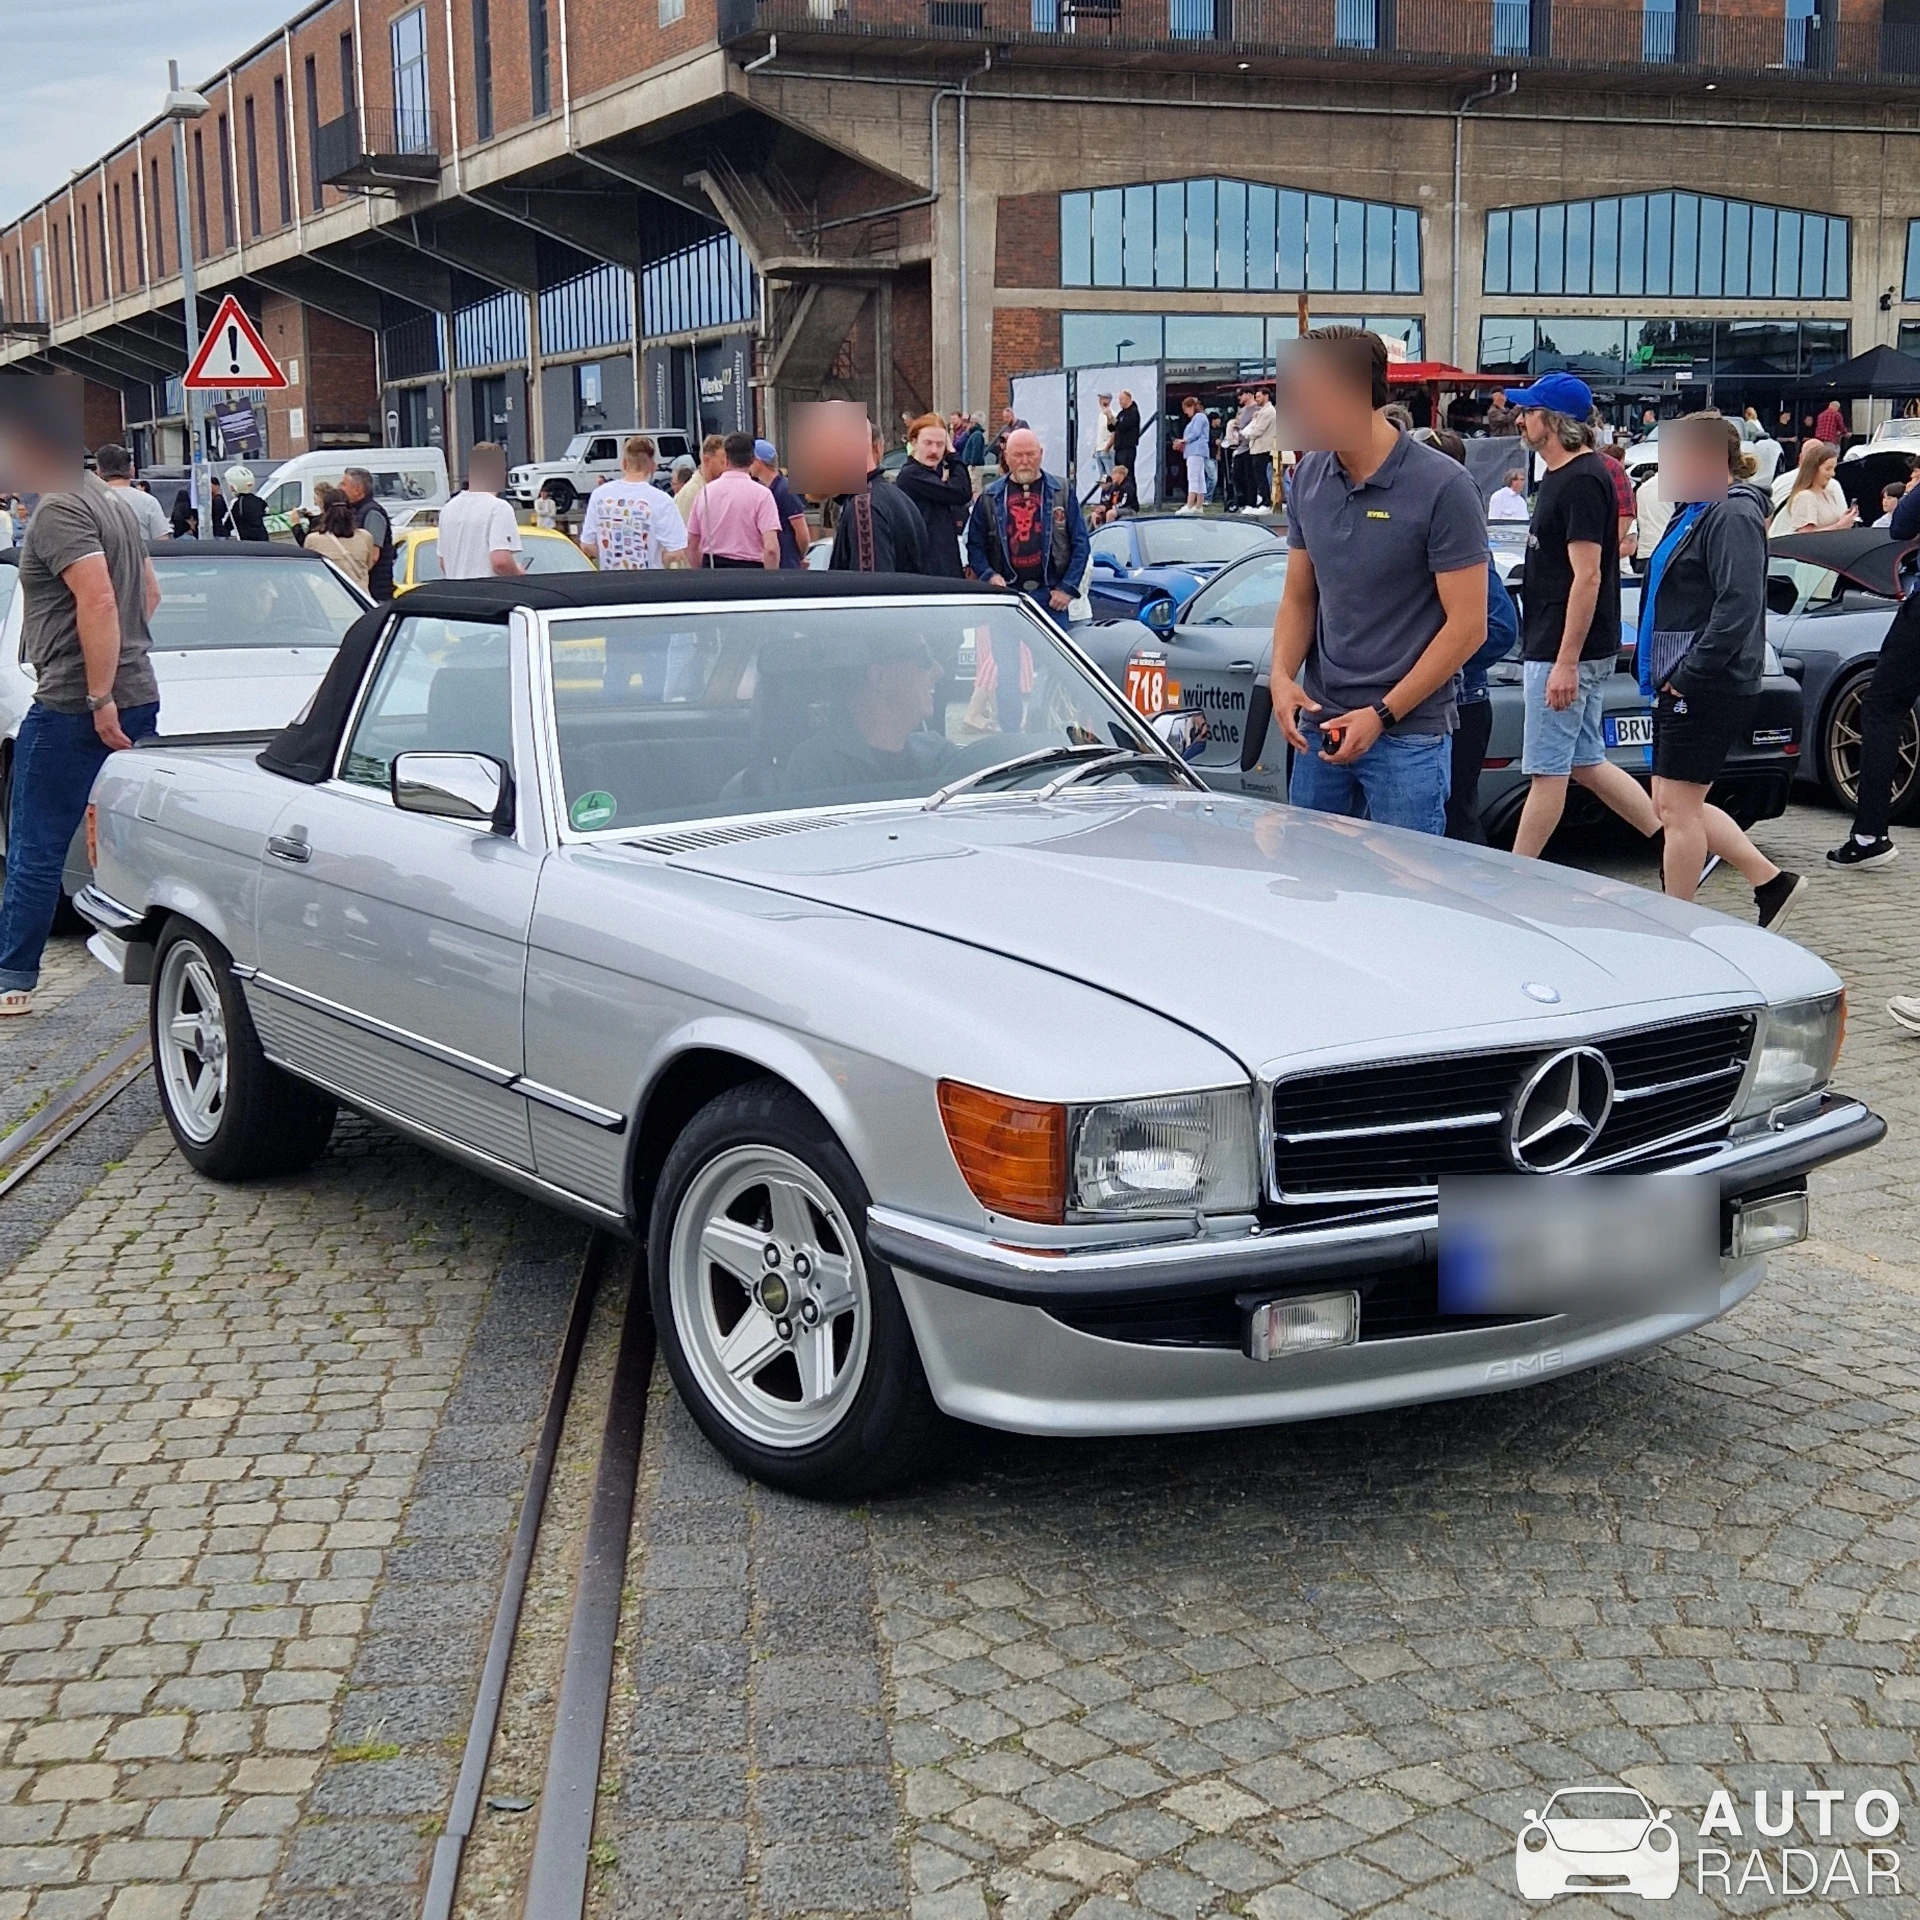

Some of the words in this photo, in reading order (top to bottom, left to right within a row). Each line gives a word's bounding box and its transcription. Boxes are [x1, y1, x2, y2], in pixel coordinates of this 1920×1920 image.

[1129, 670, 1163, 712] 718
[1183, 684, 1246, 710] württem
[1617, 719, 1651, 741] BRV
[1484, 1348, 1564, 1380] AMG
